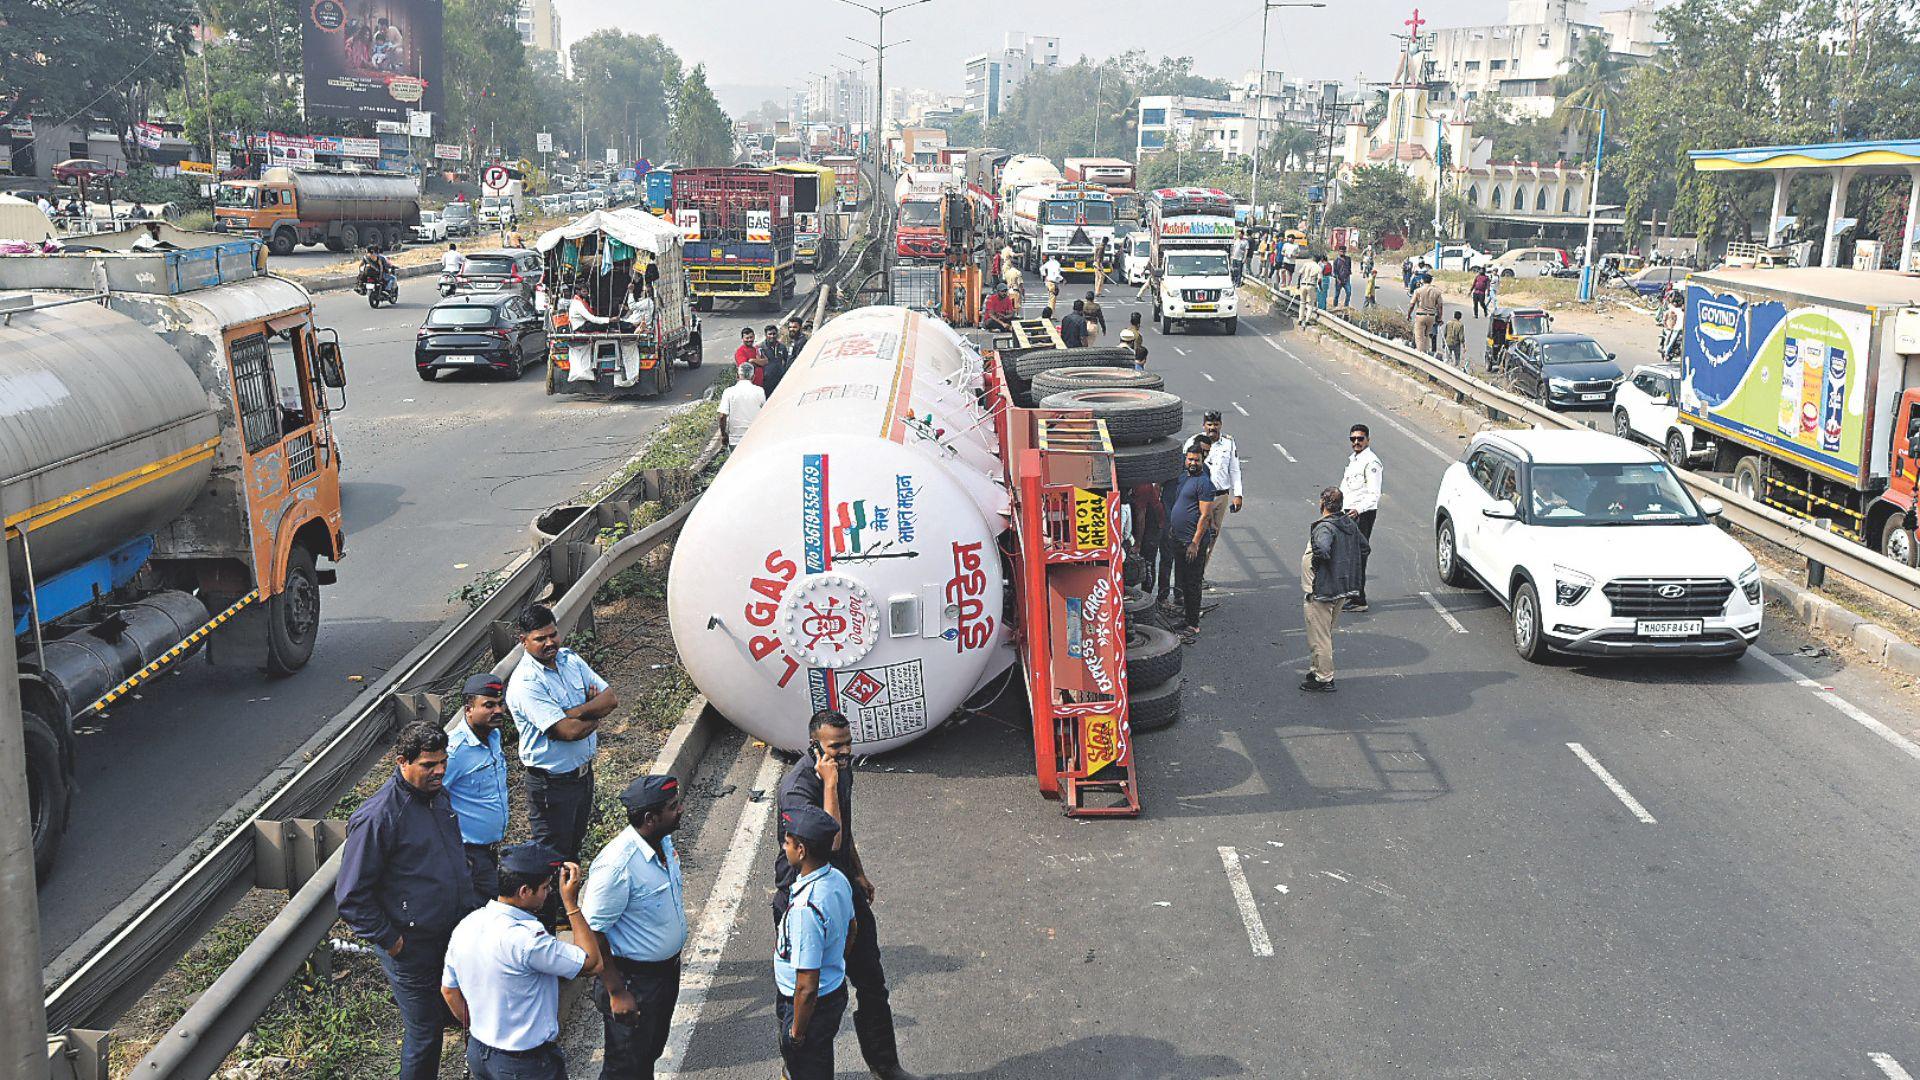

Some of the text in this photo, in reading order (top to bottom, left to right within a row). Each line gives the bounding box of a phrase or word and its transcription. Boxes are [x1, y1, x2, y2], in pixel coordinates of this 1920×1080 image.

[678, 215, 770, 229] HP GAS
[1701, 305, 1736, 327] GOVIND
[1082, 578, 1113, 692] EXPRESS CARGO
